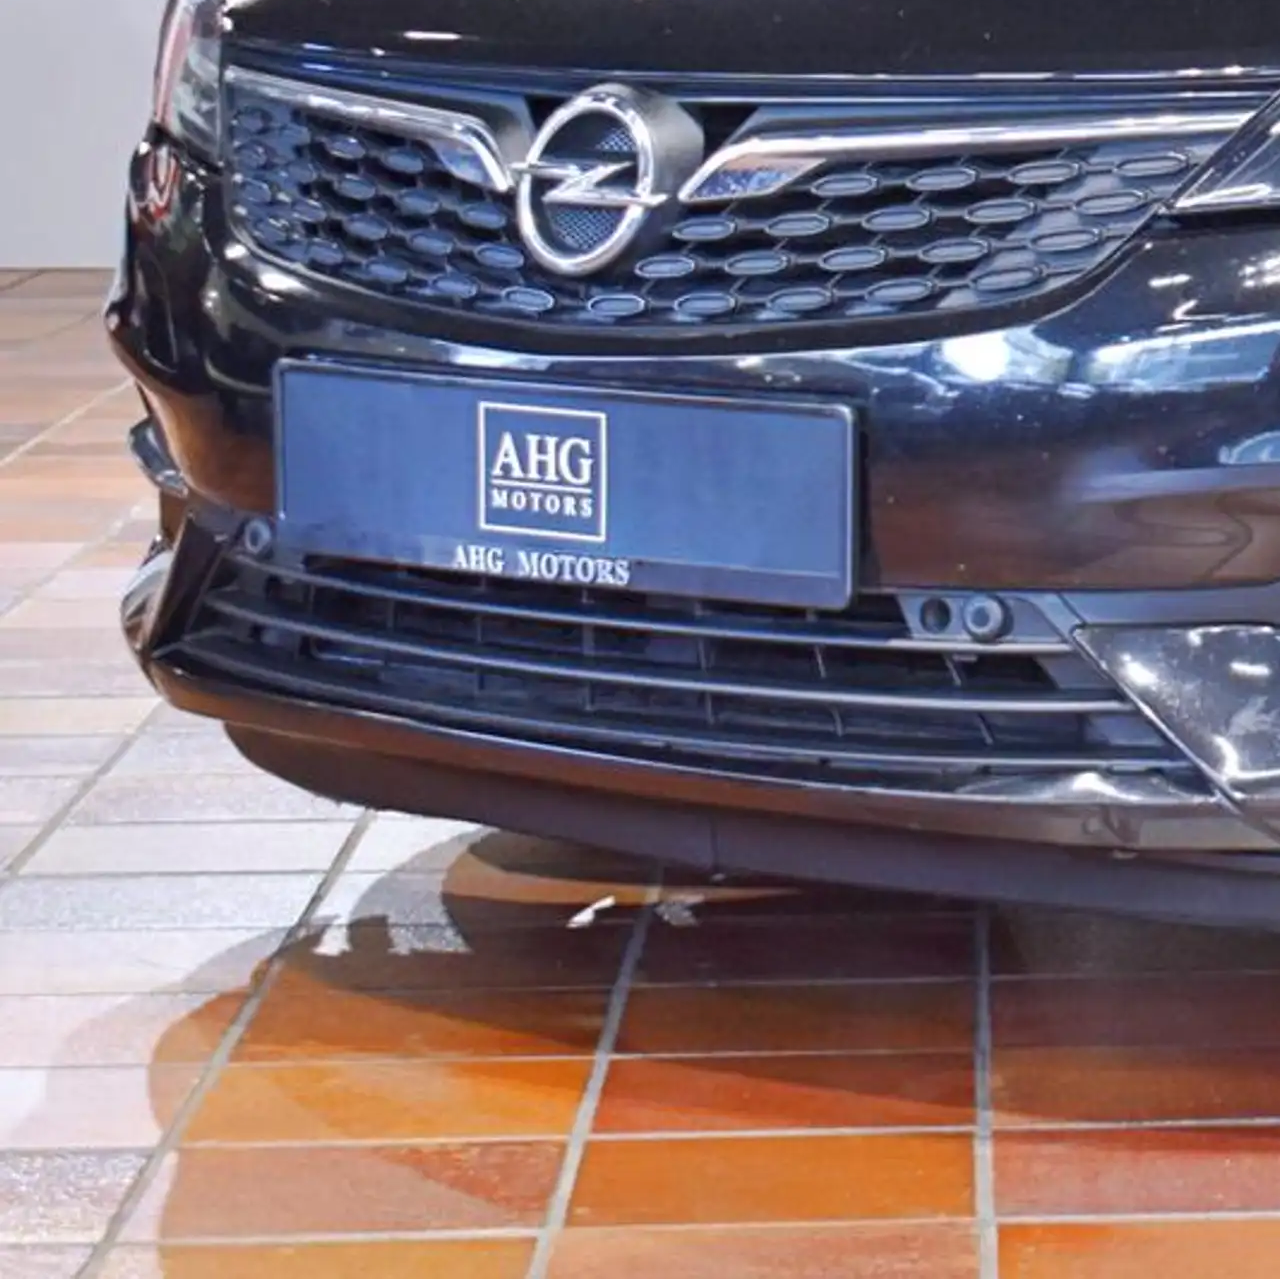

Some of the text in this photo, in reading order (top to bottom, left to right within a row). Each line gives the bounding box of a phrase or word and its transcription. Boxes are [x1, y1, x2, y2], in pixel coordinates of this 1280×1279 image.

[492, 432, 593, 485] AHG
[491, 489, 593, 517] MOTORS
[453, 544, 630, 585] AHG MOTORS
